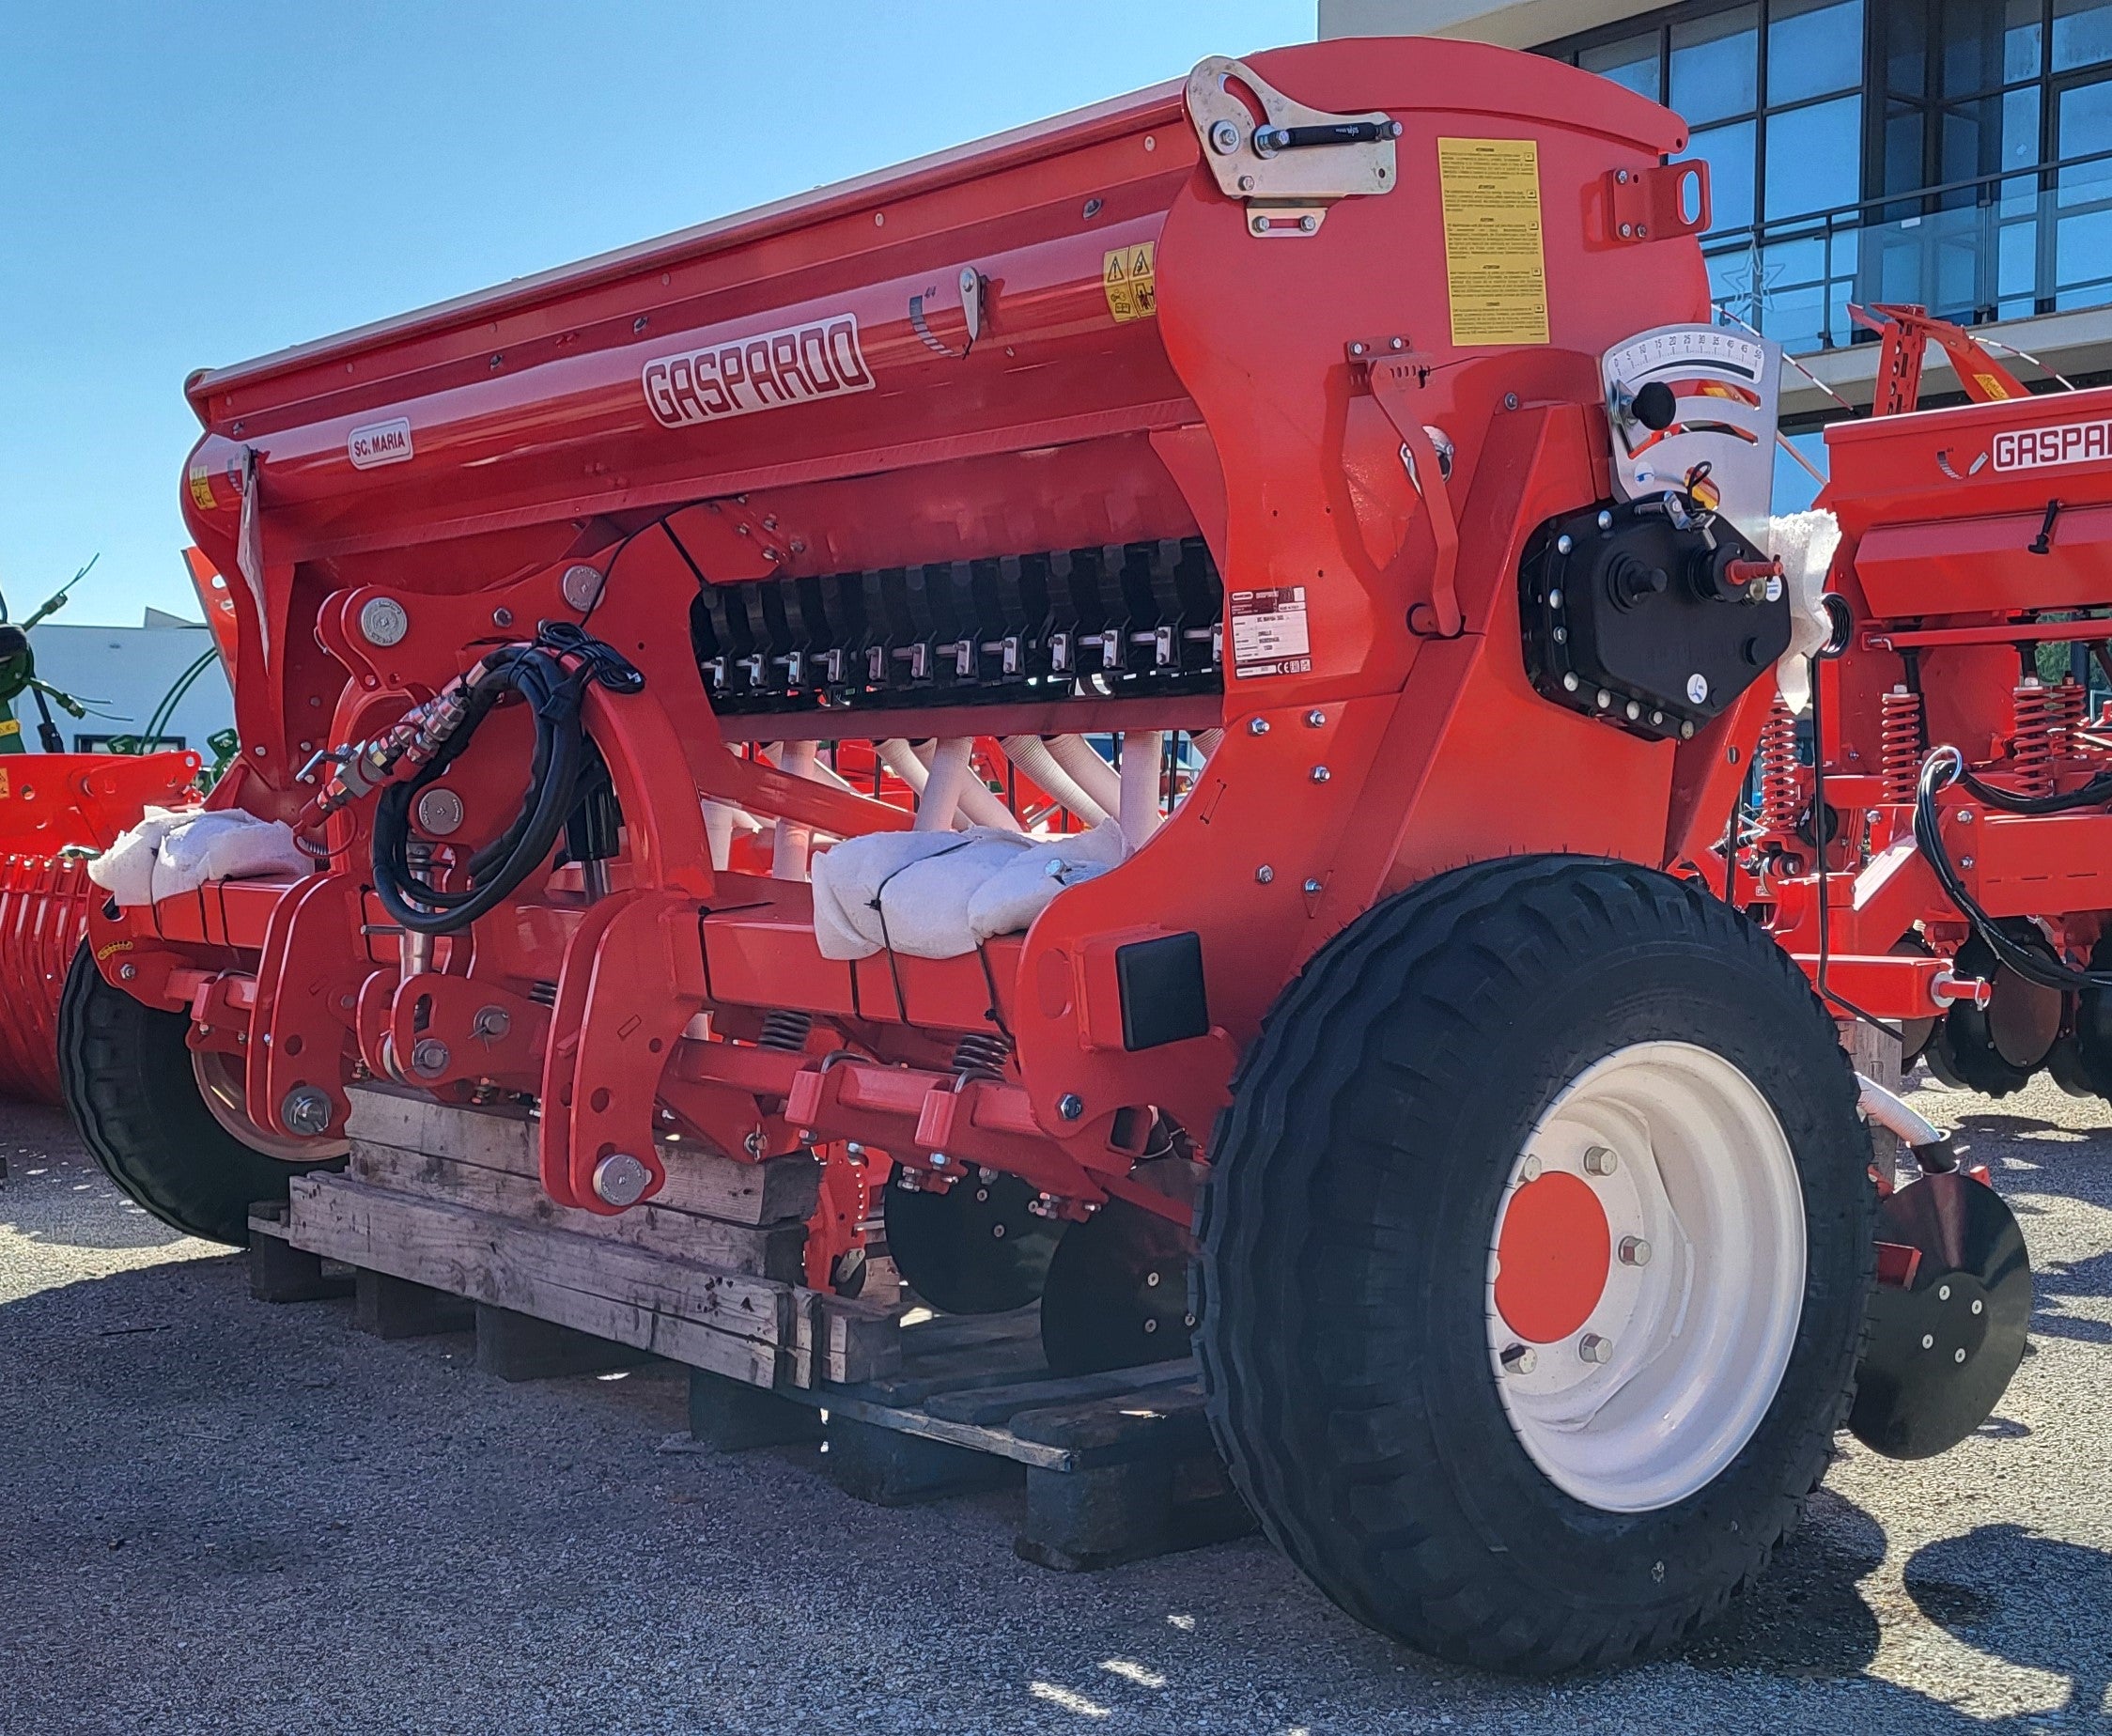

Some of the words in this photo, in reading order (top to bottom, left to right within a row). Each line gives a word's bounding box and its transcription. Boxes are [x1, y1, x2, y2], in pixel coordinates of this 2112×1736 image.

[1626, 350, 1631, 360] 5
[1639, 344, 1646, 354] 10
[1654, 339, 1662, 349] 15
[1669, 335, 1676, 346] 20
[1684, 334, 1691, 344] 25
[1699, 334, 1705, 344] 30
[1713, 336, 1719, 346] 35
[1727, 339, 1734, 349] 40
[1741, 344, 1748, 353] 45
[1754, 349, 1763, 359] 50
[645, 320, 870, 424] GASPARDO
[354, 439, 371, 457] SC.
[372, 431, 405, 454] MARIA
[1996, 424, 2112, 468] GASPA
